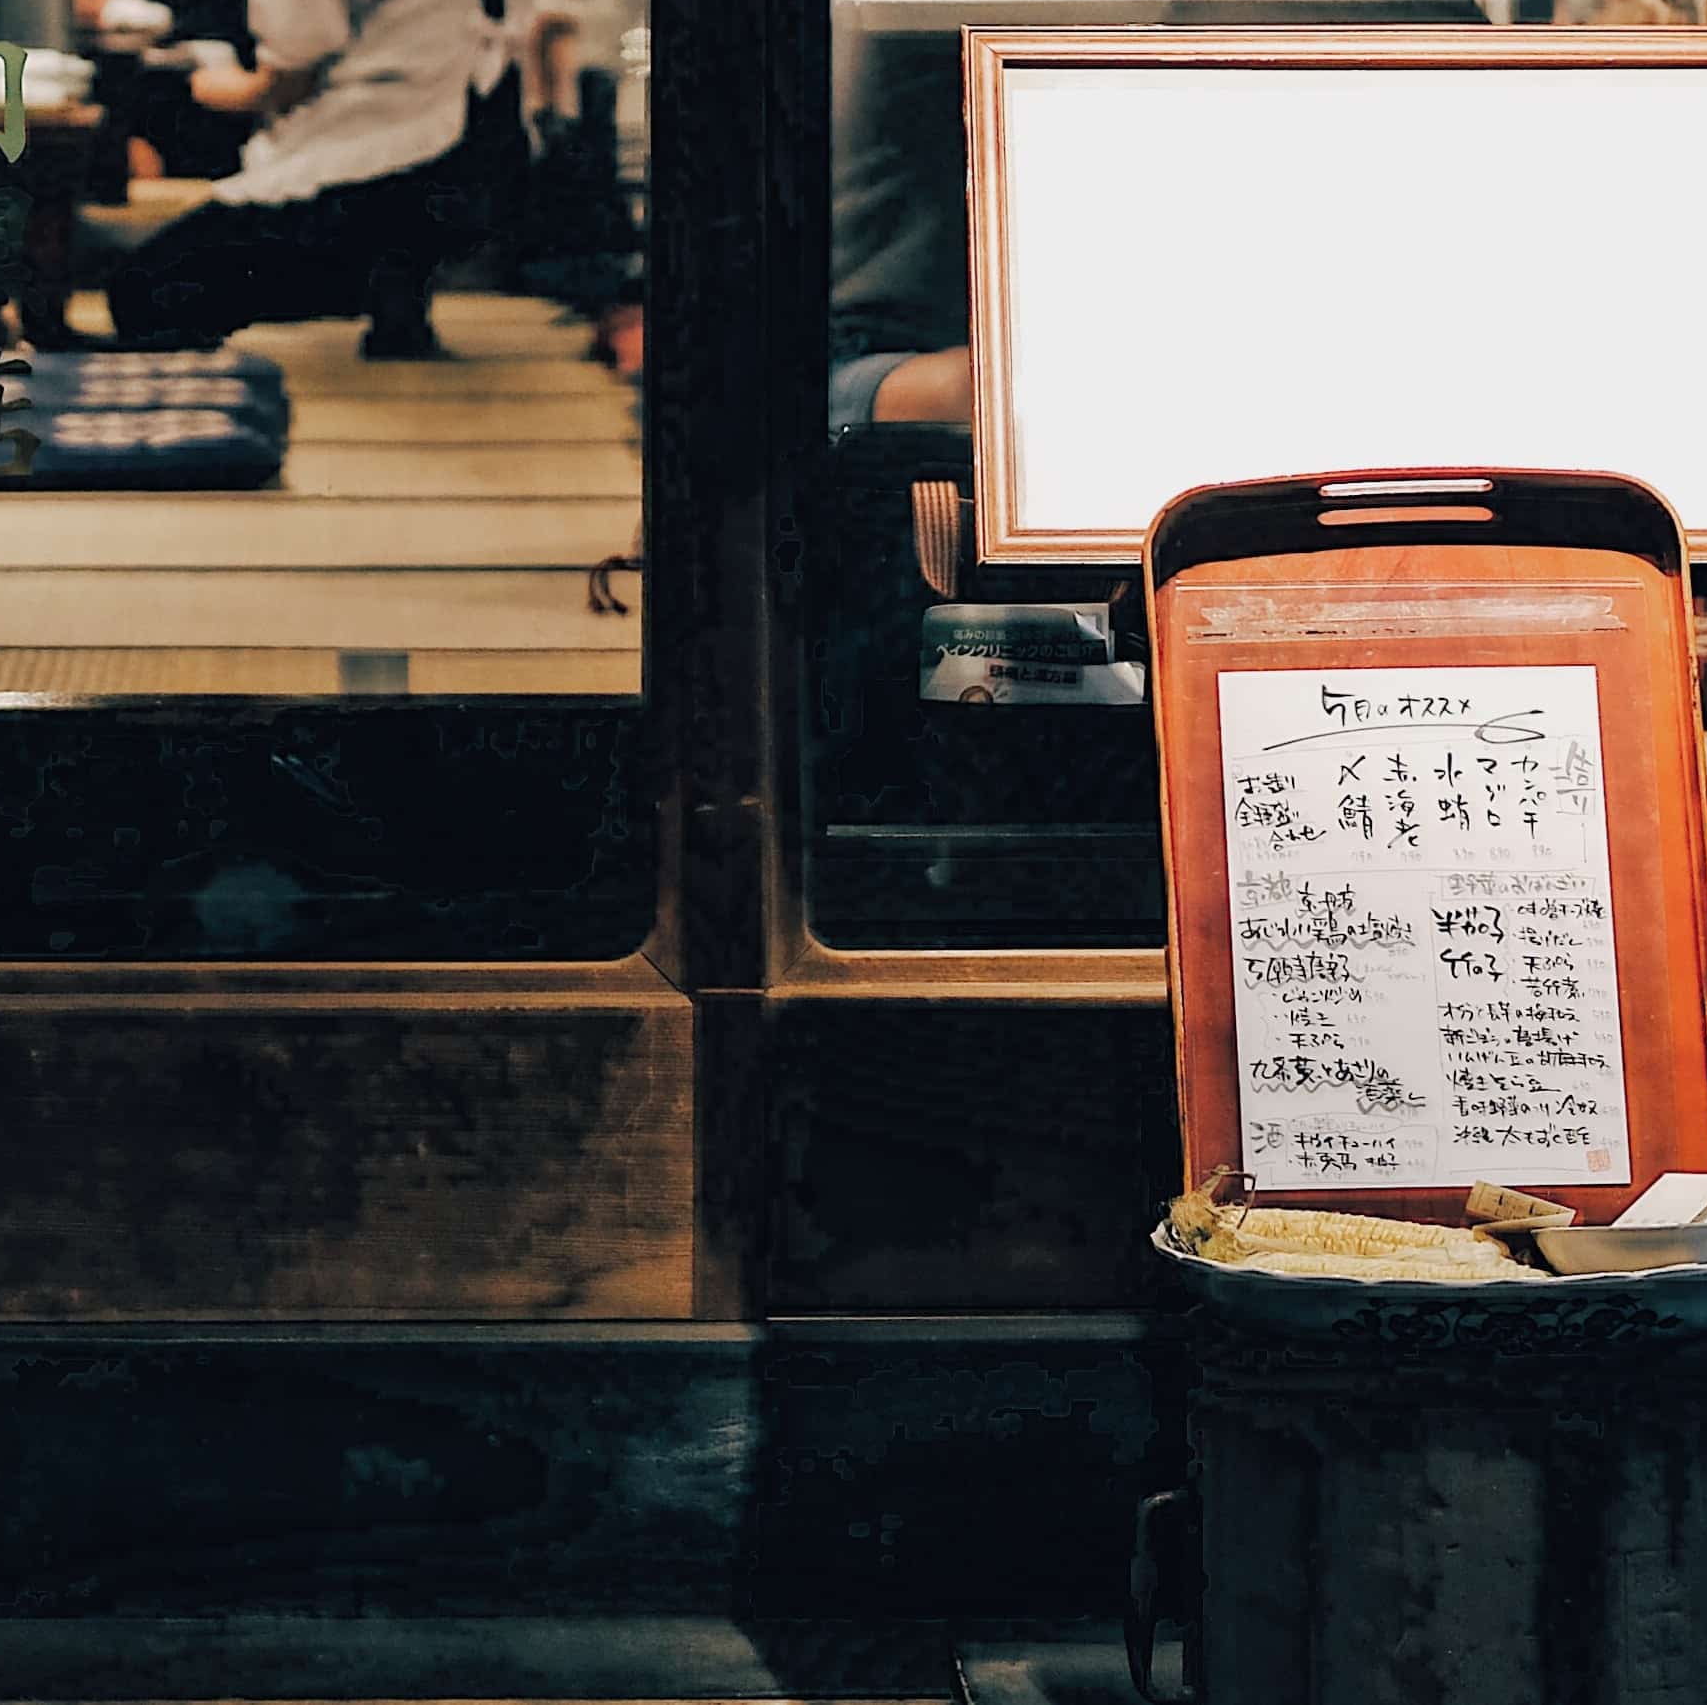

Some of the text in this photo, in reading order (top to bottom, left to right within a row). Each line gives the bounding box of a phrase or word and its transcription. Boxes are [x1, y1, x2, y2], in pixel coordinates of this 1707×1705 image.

[1434, 753, 1470, 831] 水蛸
[1477, 759, 1505, 827] マグロ
